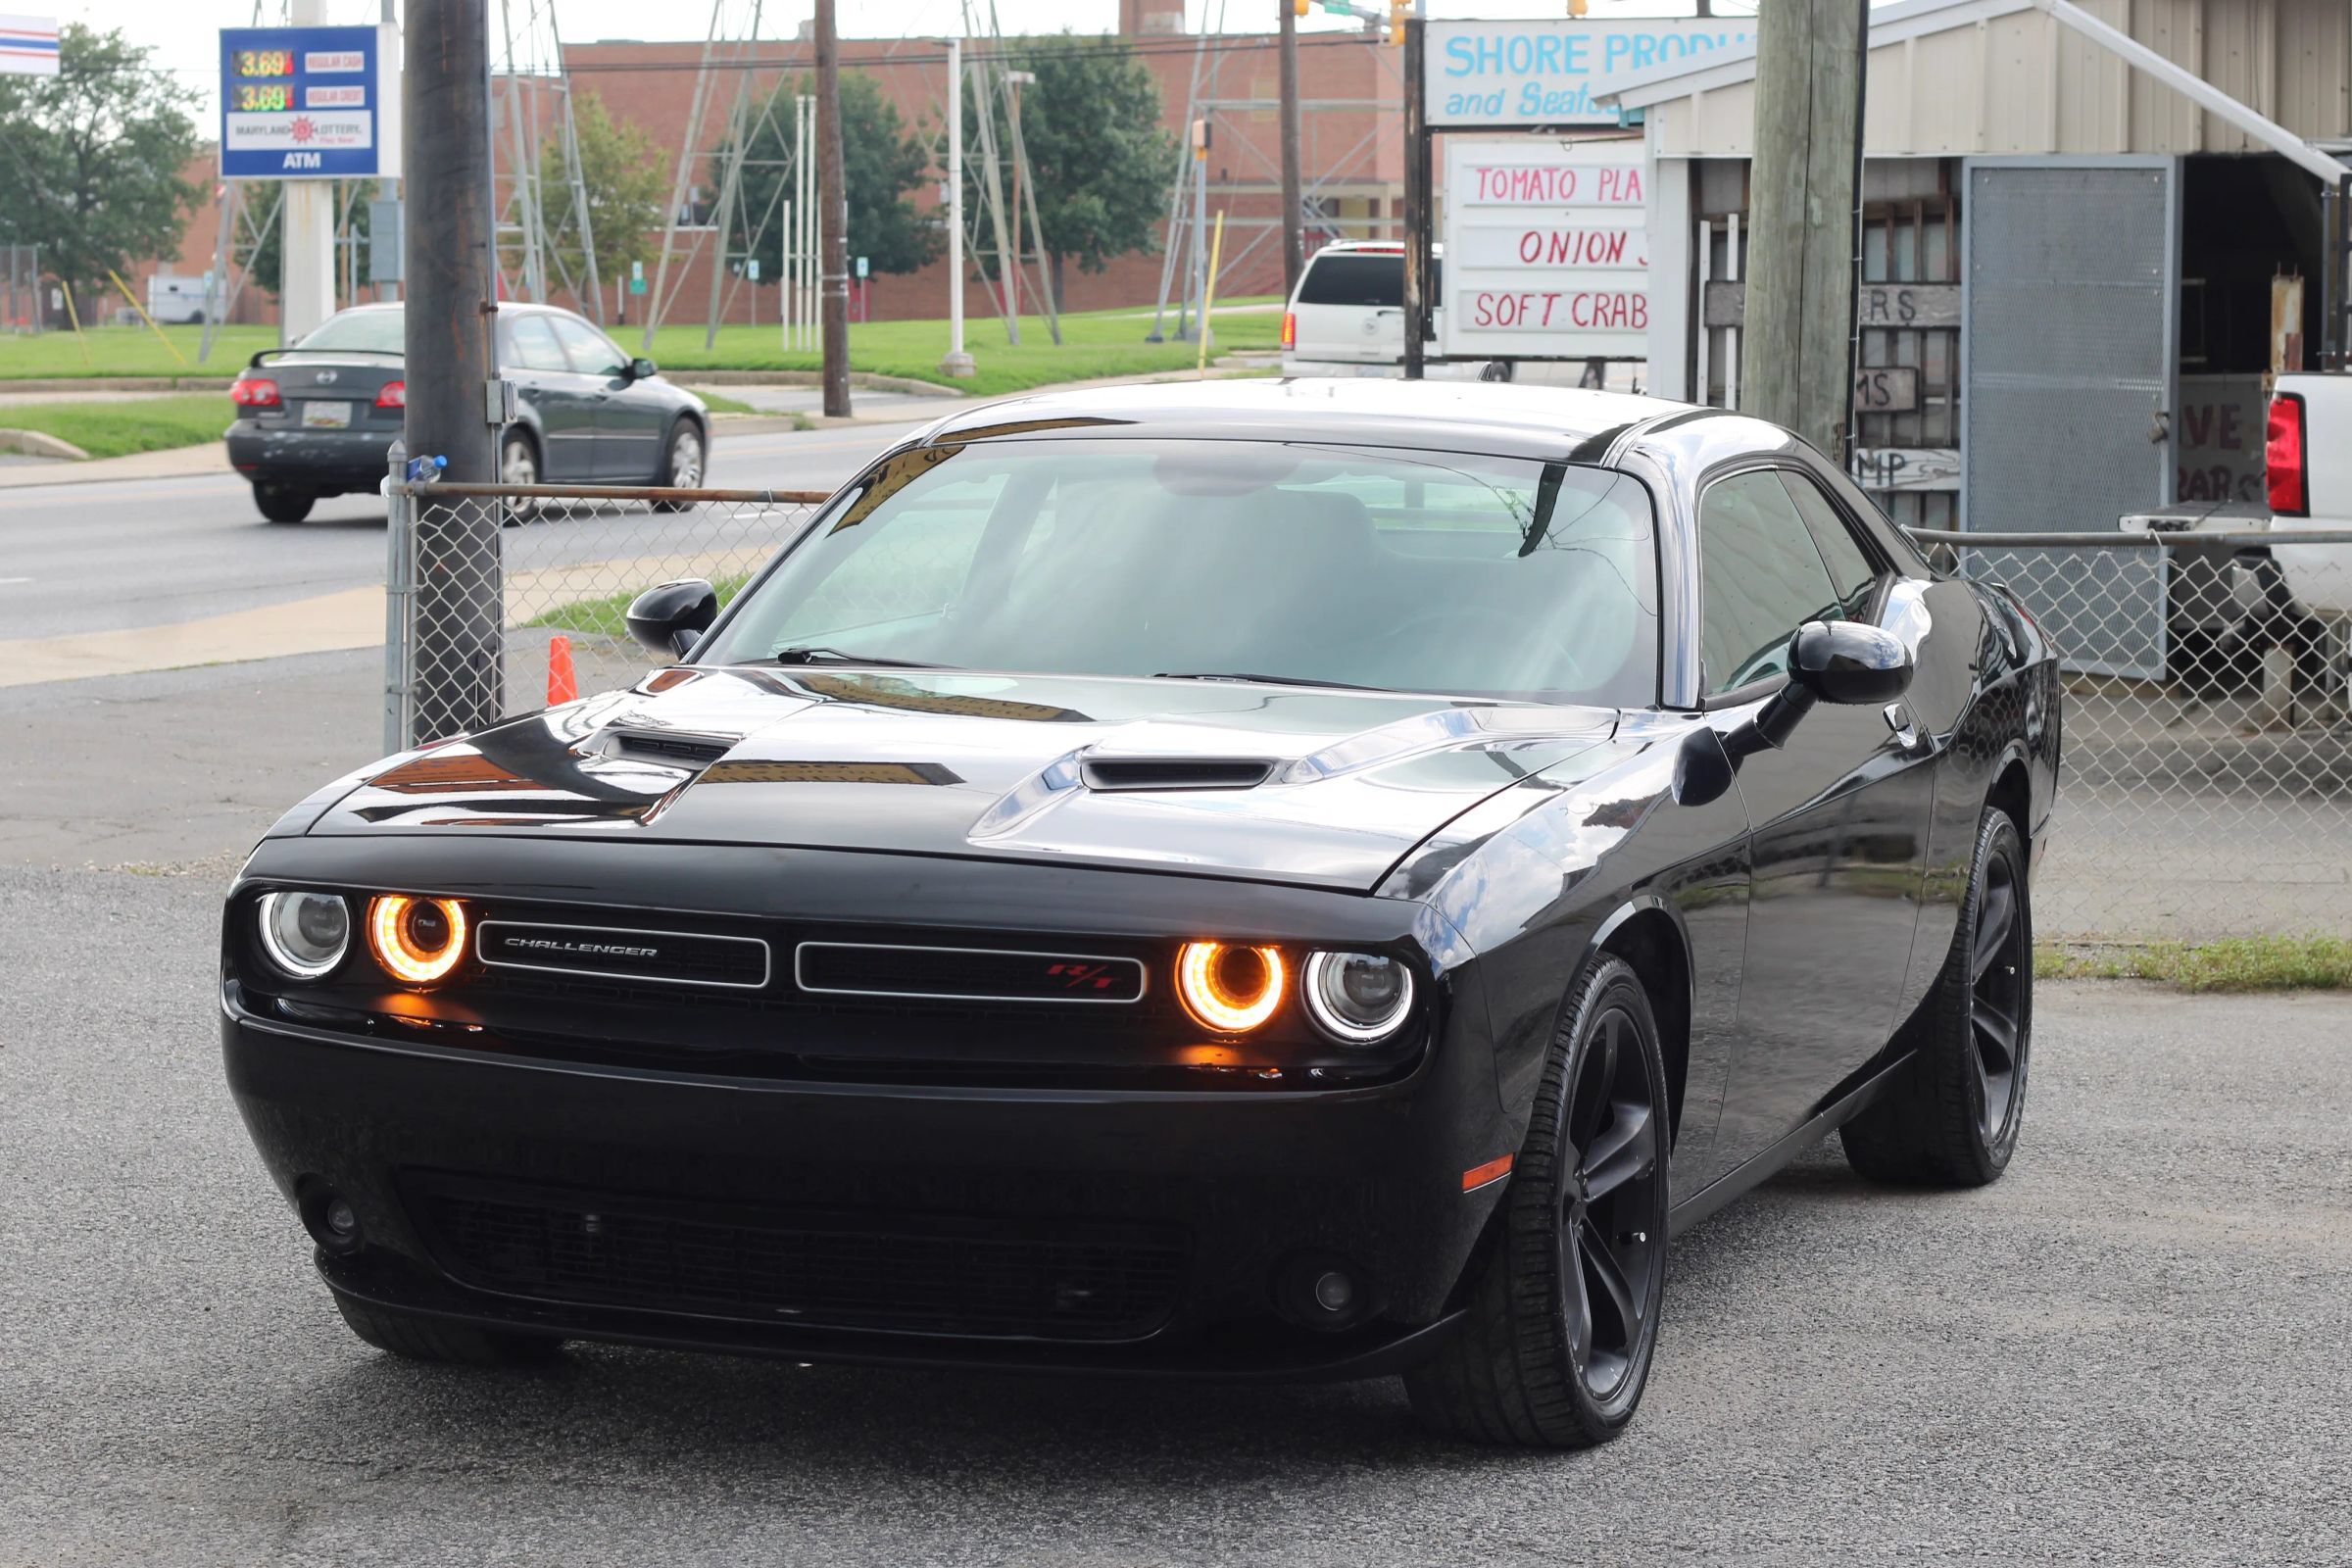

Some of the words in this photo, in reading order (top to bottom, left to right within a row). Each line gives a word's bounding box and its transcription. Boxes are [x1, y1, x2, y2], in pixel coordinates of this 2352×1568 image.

[1445, 34, 1592, 77] SHORE
[1445, 88, 1506, 116] and
[235, 124, 290, 136] MARYLAND
[282, 152, 321, 169] ATM
[1475, 168, 1577, 202] TOMATO
[1597, 168, 1642, 202] PLA
[1519, 230, 1628, 265] ONION
[1475, 292, 1563, 327] SOFT
[1571, 292, 1648, 329] CRAB
[1860, 289, 1917, 321] RS
[505, 938, 658, 957] CHALLENGER
[1048, 963, 1118, 989] R/T
